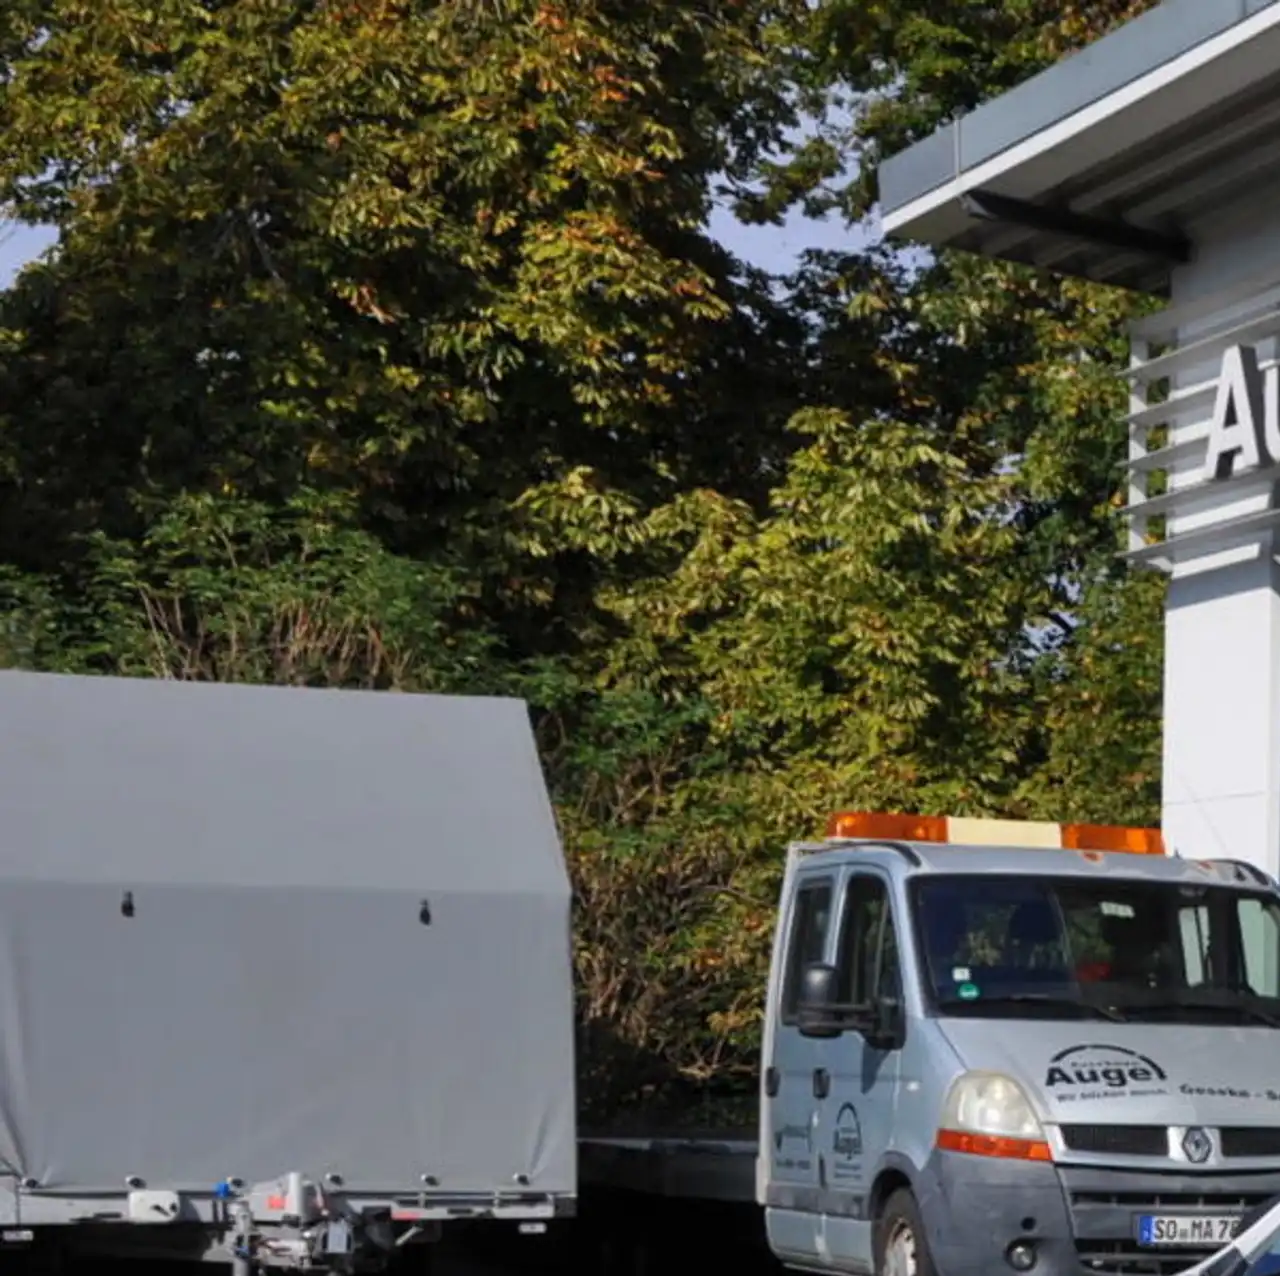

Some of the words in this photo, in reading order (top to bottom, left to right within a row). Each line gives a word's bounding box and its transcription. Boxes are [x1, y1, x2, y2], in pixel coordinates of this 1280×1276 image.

[1045, 1066, 1152, 1087] Auge
[1155, 1219, 1177, 1240] SO
[1191, 1219, 1213, 1240] MA
